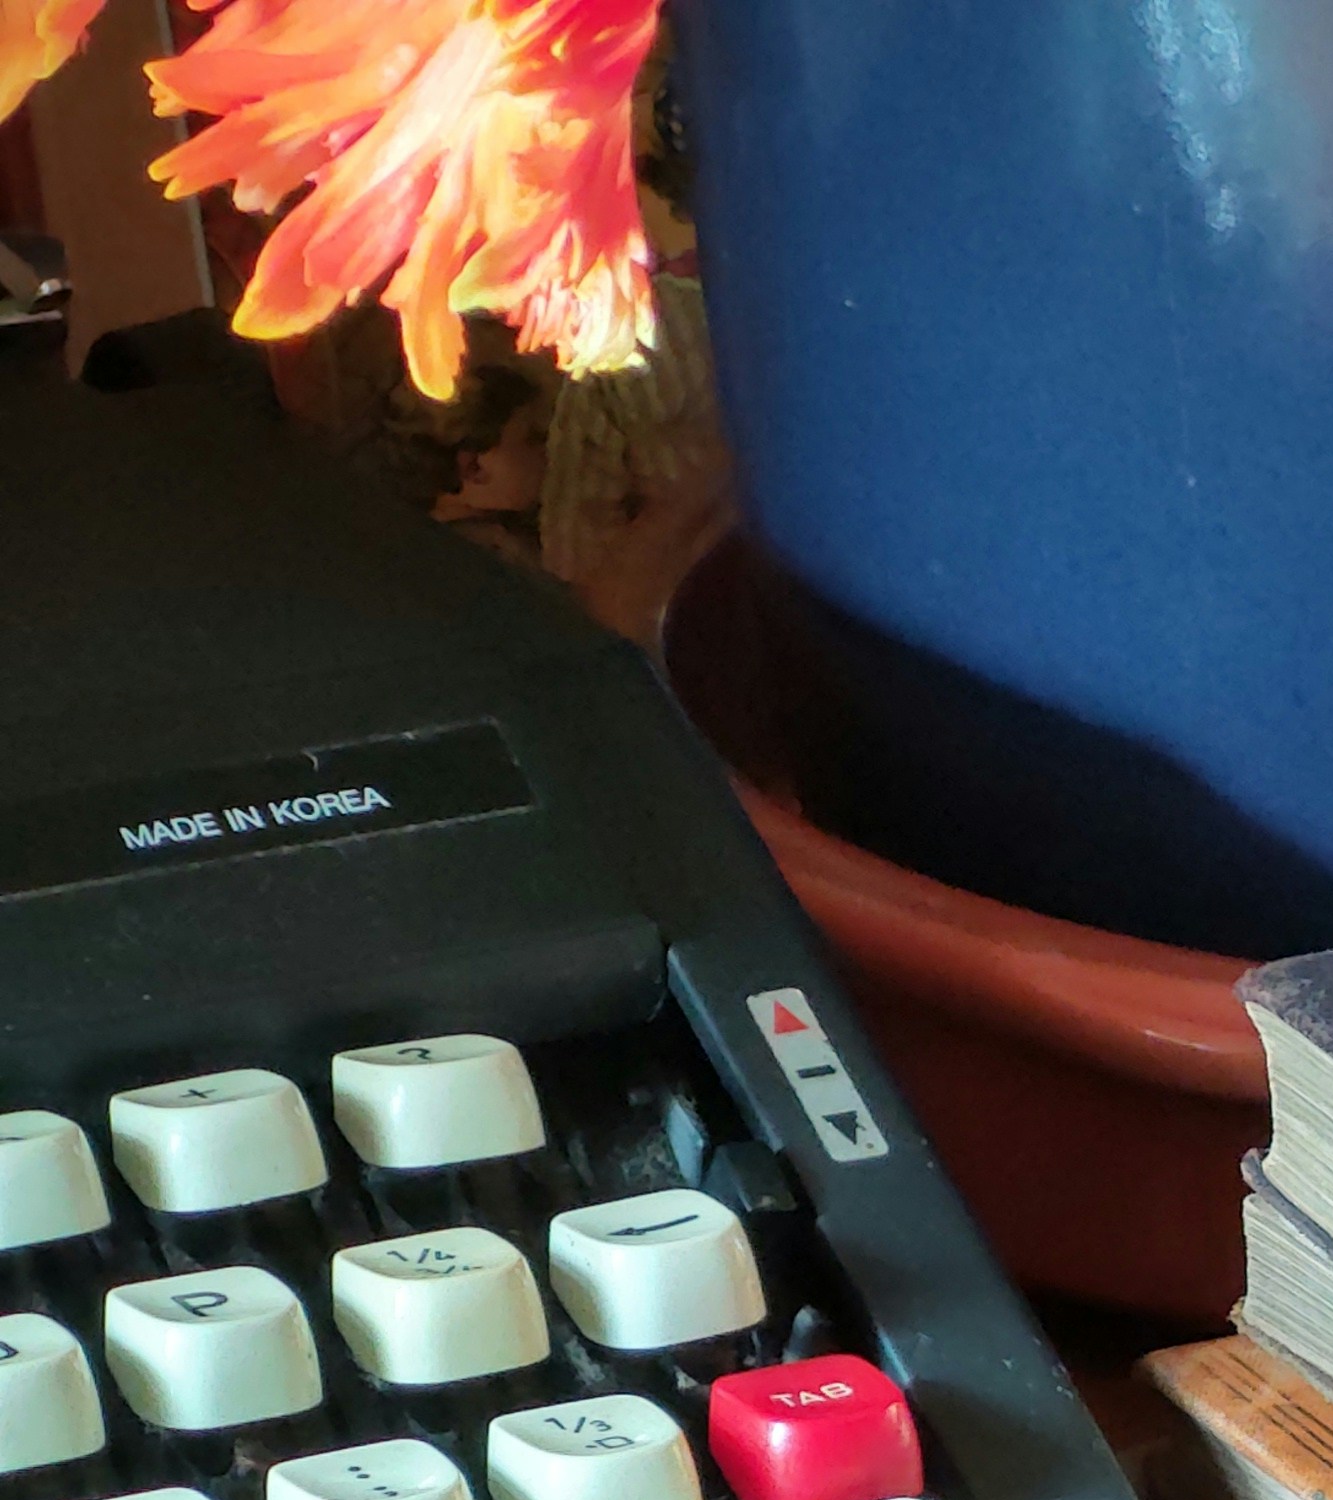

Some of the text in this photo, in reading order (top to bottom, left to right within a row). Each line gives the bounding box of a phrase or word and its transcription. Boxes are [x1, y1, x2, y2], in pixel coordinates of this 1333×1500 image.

[119, 787, 393, 850] MADE IN KOREA
[171, 1290, 230, 1318] P
[769, 1381, 855, 1410] TAB
[543, 1414, 614, 1434] 1/3
